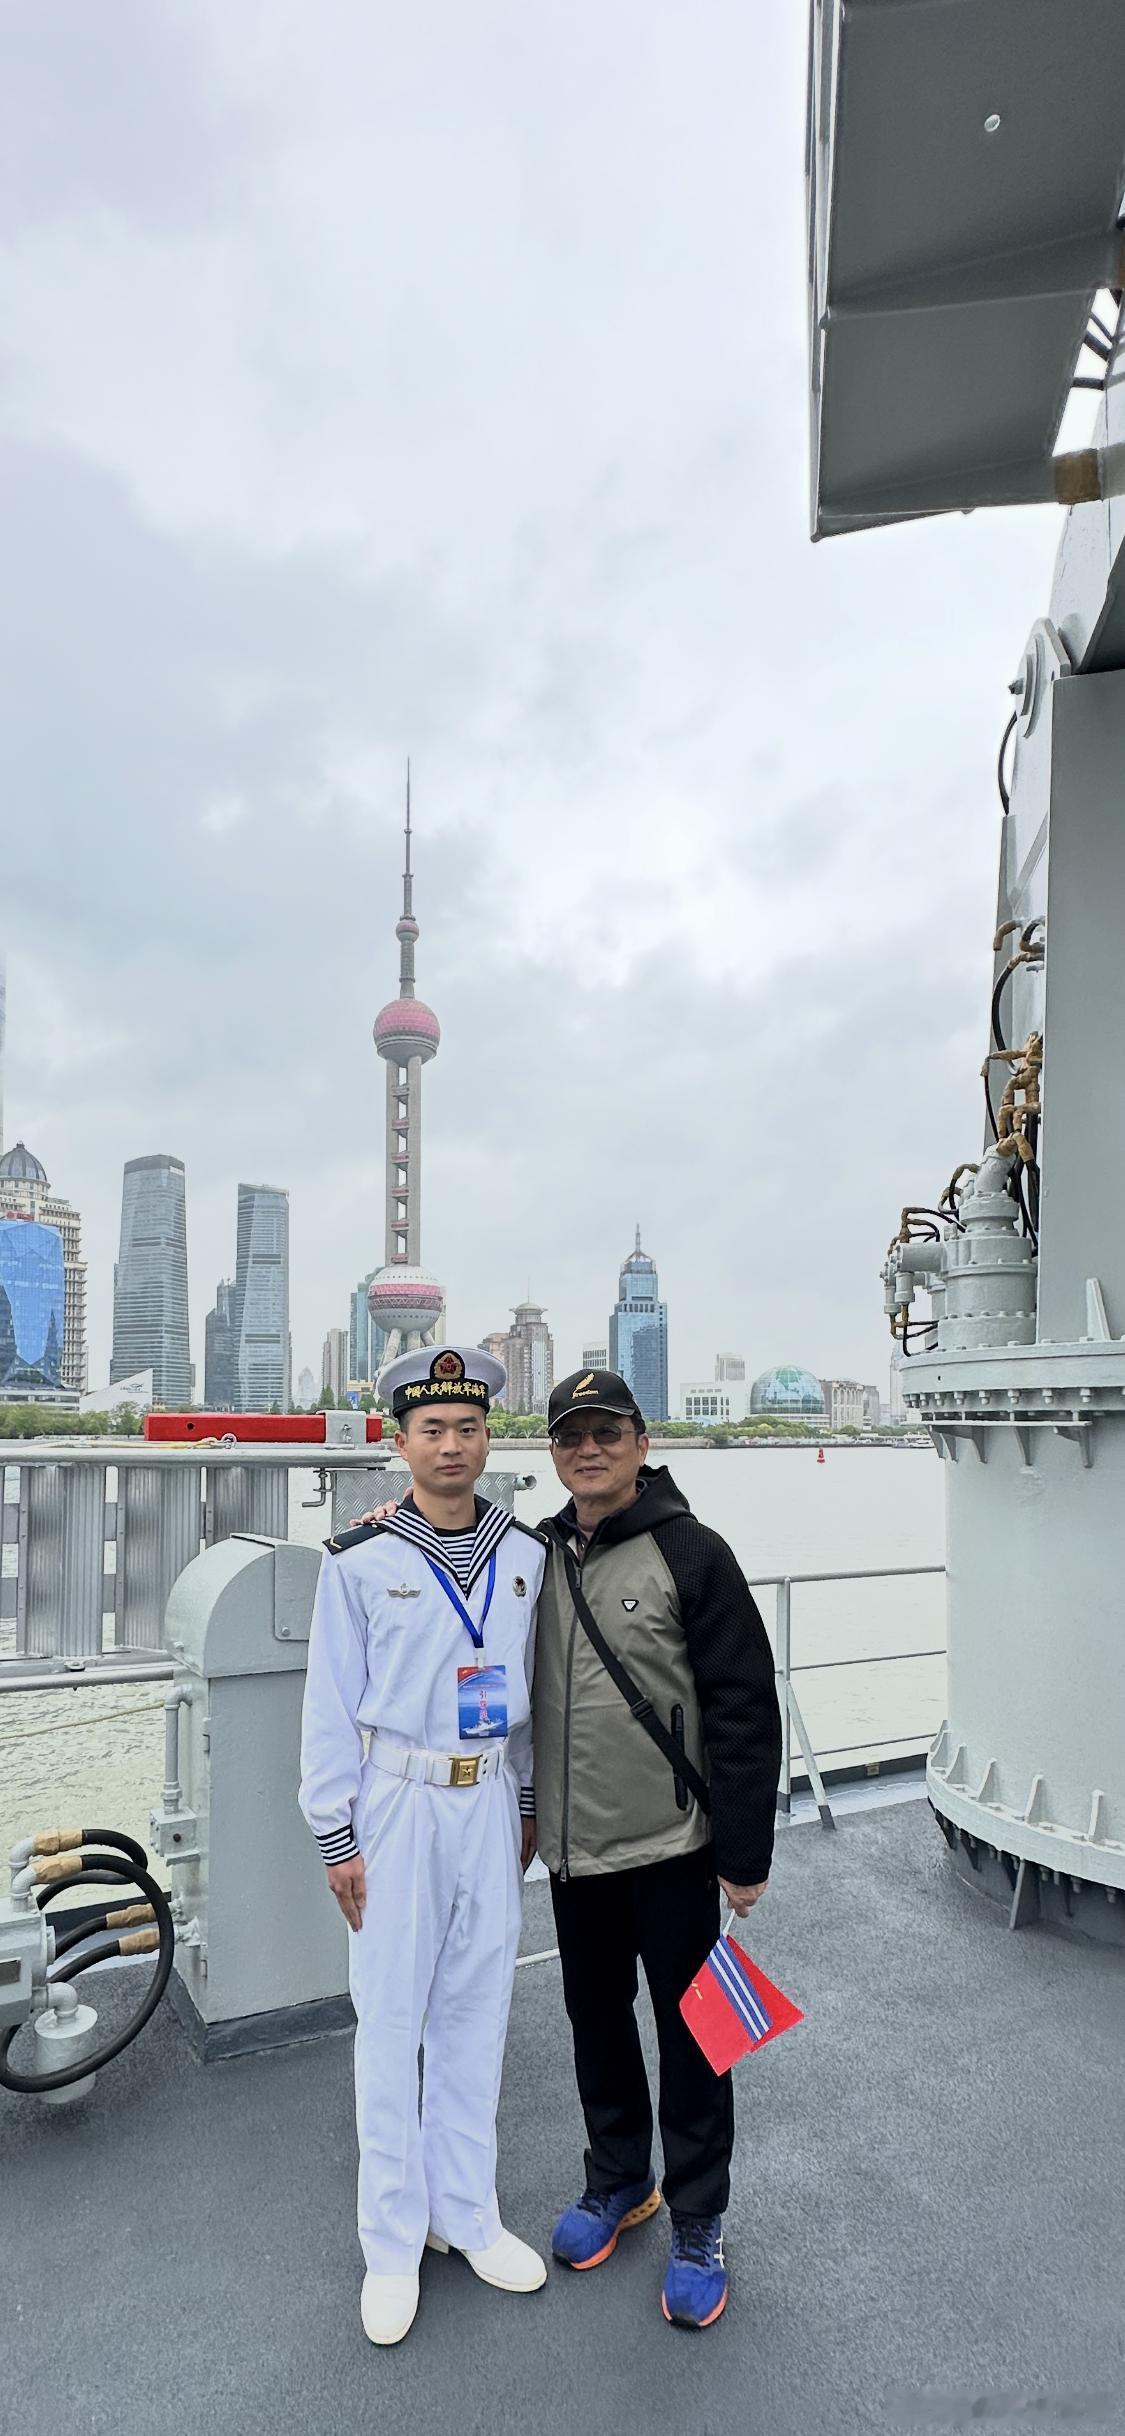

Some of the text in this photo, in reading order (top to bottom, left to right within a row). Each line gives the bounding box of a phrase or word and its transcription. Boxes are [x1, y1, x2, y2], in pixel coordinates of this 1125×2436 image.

[405, 1382, 486, 1400] 中国人民解放军海军
